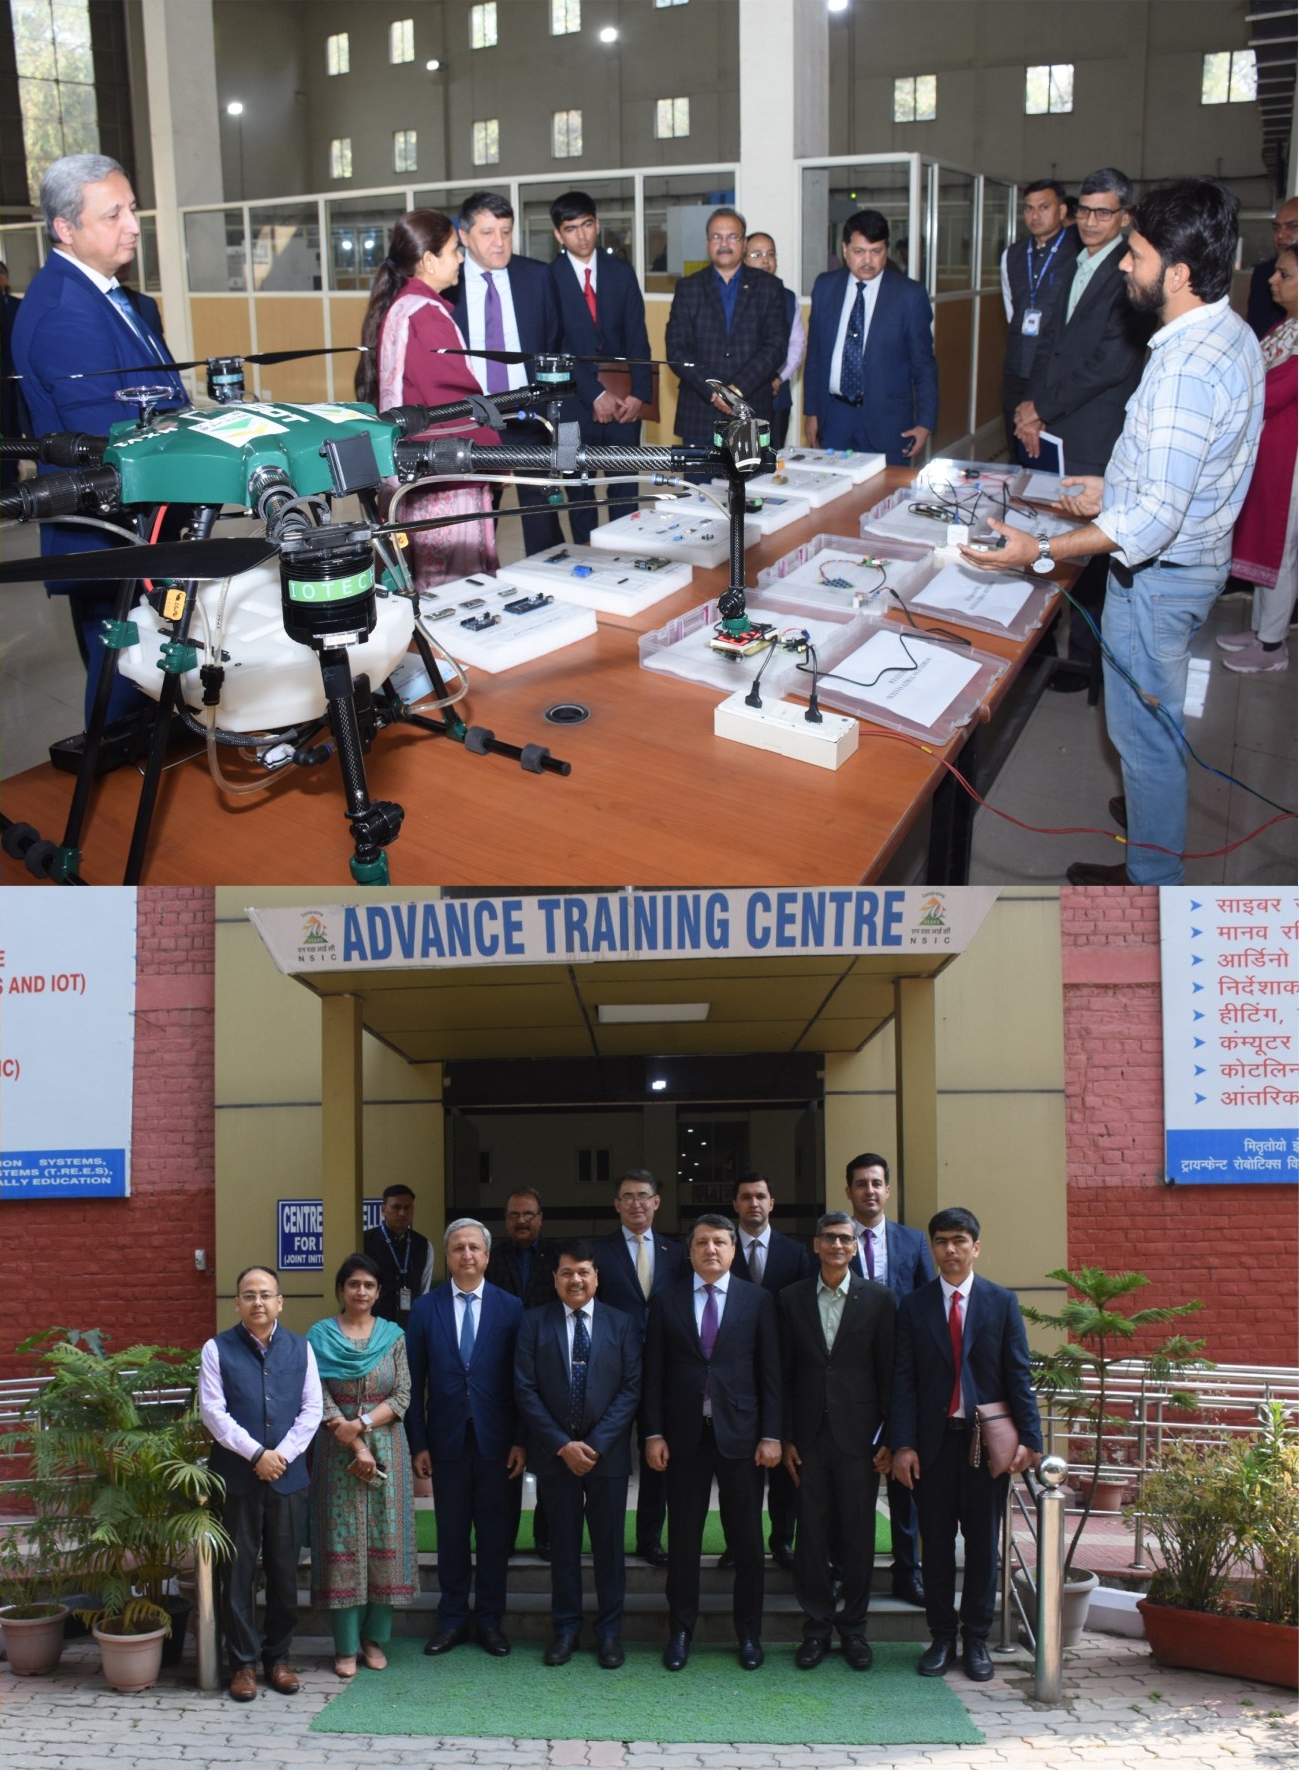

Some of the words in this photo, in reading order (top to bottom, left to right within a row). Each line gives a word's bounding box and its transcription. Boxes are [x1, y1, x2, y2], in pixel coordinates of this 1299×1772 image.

[1215, 898, 1282, 916] साइबर
[343, 900, 525, 962] ADVANCE
[537, 892, 730, 954] TRAINING
[746, 891, 906, 950] CENTRE
[1216, 926, 1268, 940] मानव
[1217, 947, 1289, 968] आर्डिनो
[8, 975, 46, 994] AND
[51, 973, 86, 995] IOT)
[1218, 1002, 1284, 1024] हीटिंग,
[39, 1157, 107, 1166] SYSTEMS,
[32, 1177, 111, 1186] EDUCATION
[283, 1205, 323, 1233] CENTRE
[294, 1237, 316, 1251] FOR
[284, 1254, 306, 1265] (JOINT
